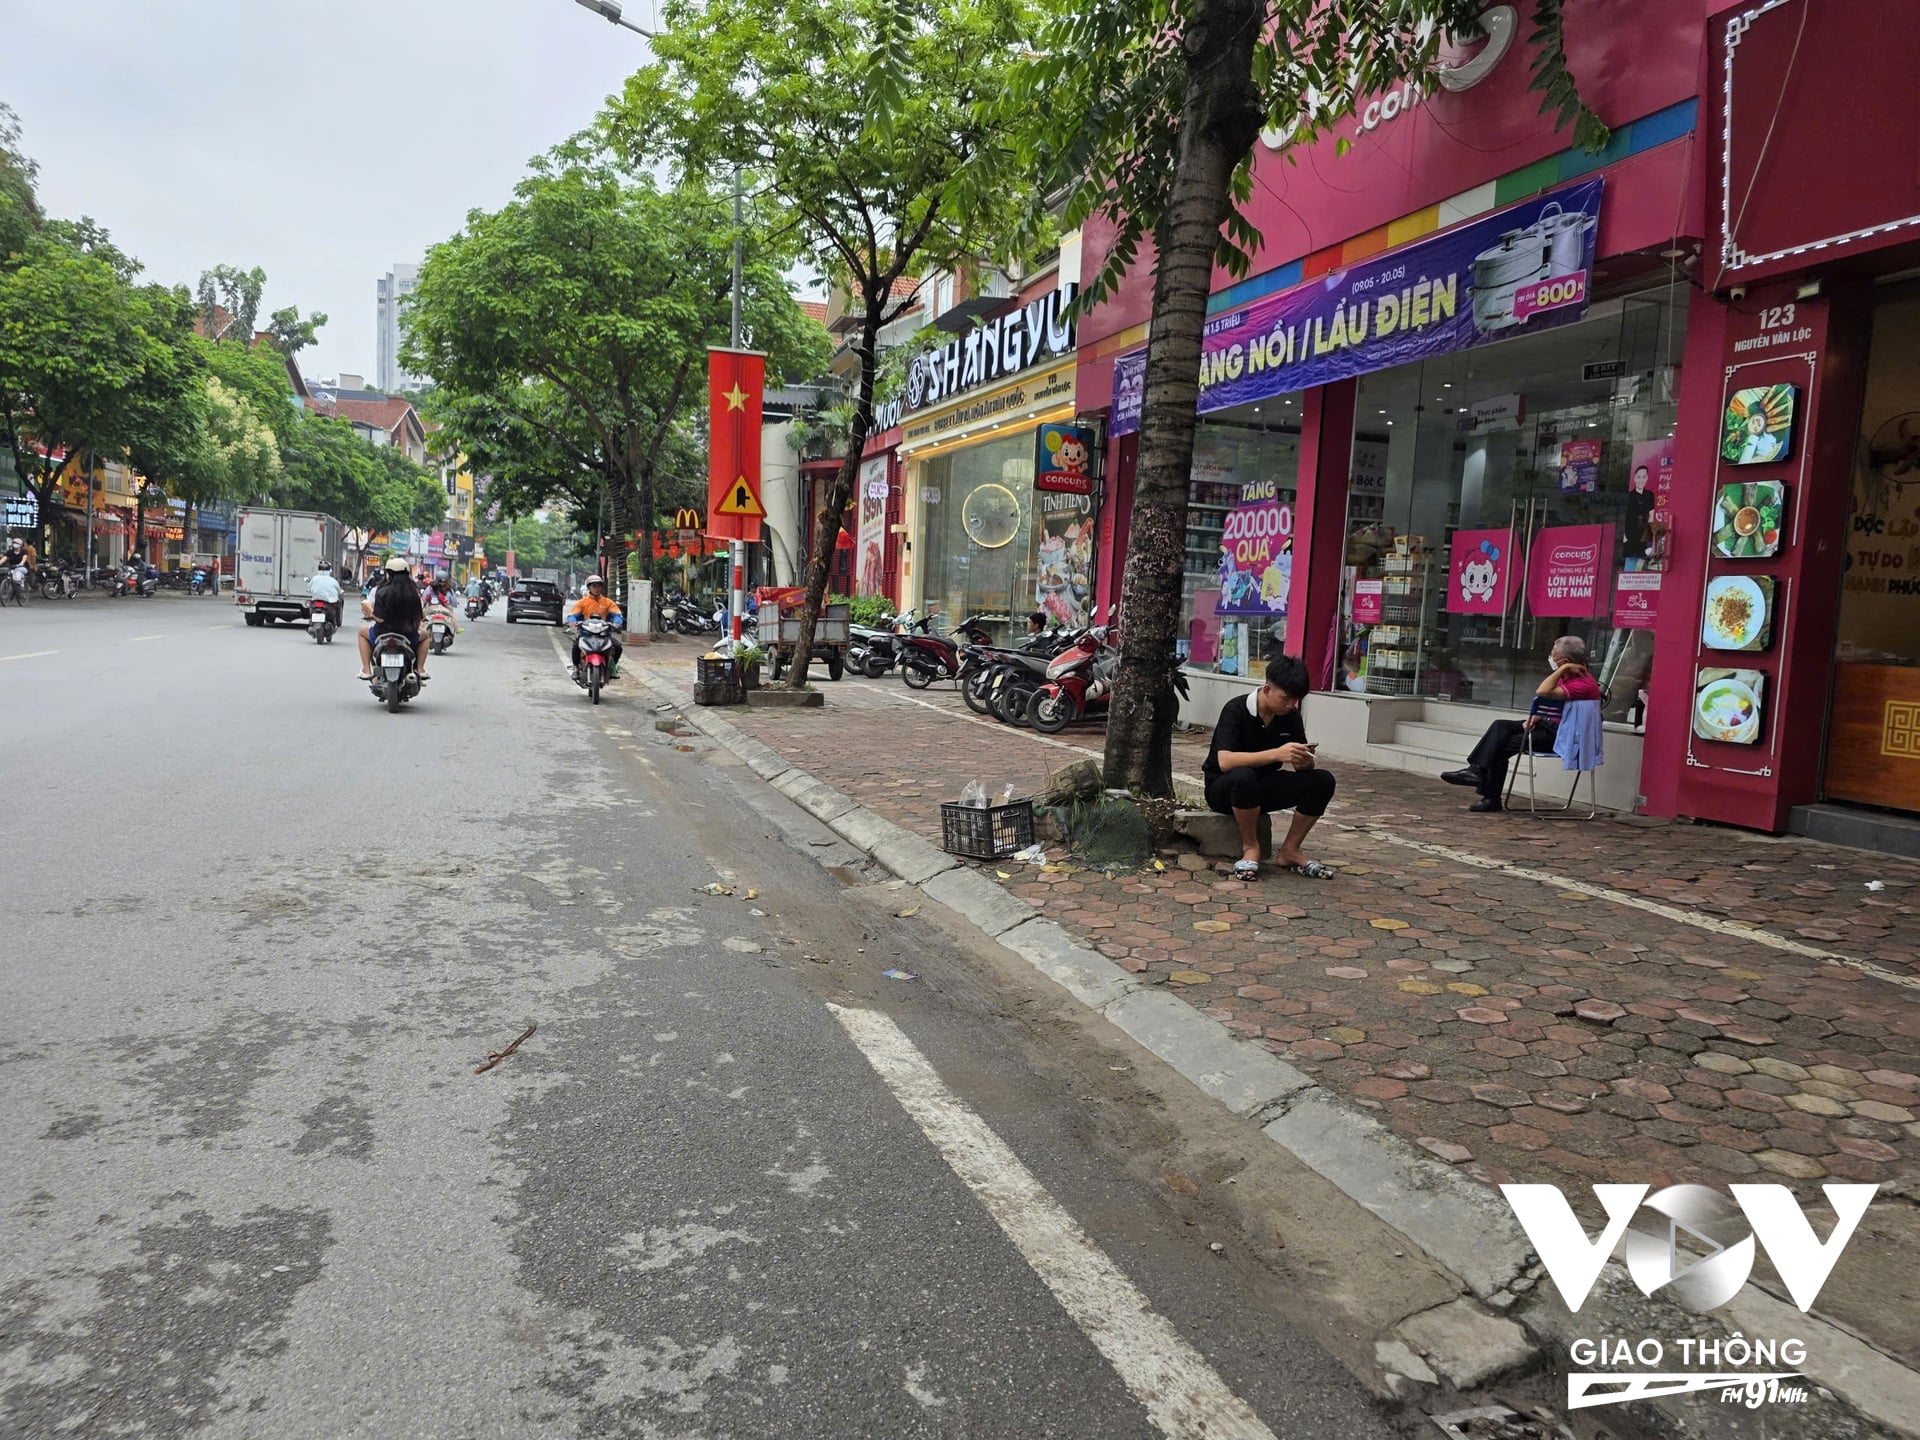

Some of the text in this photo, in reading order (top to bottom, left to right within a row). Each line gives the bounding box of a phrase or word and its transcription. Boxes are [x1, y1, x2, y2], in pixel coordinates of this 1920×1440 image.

[1381, 264, 1406, 284] 20.05)
[1210, 321, 1220, 334] 1.5
[1220, 313, 1241, 333] TRIỆU
[1759, 303, 1796, 330] 123
[928, 284, 1074, 400] SHANGYU
[1198, 344, 1244, 392] ẶNG
[1248, 319, 1295, 374] NỒI
[1314, 297, 1369, 355] LẨU
[1375, 273, 1457, 337] ĐIỆN
[1734, 327, 1812, 352] NGUYỄN VĂN LỘC
[1593, 363, 1617, 373] EXIT
[1045, 475, 1088, 489] concung
[1242, 480, 1276, 502] TẶNG
[1222, 506, 1291, 540] 200.000
[1853, 513, 1886, 537] ĐỘC
[1555, 550, 1592, 560] concung
[1857, 550, 1904, 571] TỰ DO
[1548, 573, 1595, 587] LỚN NHẤT
[1548, 586, 1592, 598] VIỆT NAM
